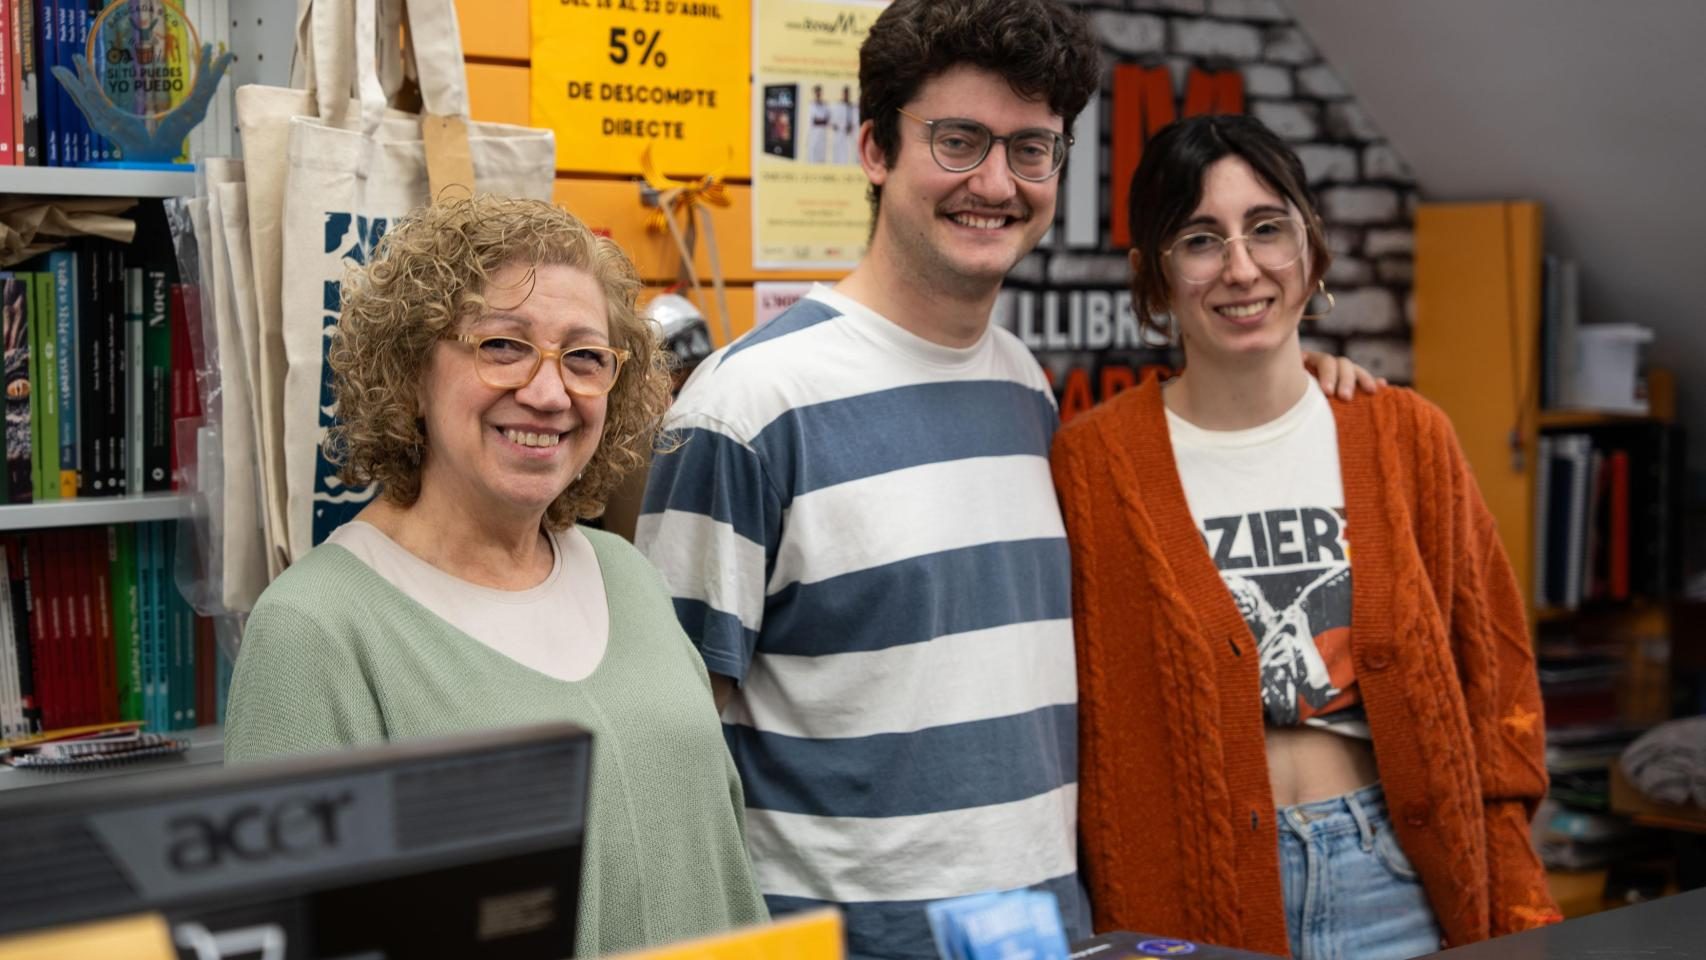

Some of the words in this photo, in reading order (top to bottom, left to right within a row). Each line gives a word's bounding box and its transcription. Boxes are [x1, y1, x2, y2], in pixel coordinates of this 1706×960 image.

[619, 0, 637, 11] AL
[609, 27, 667, 68] 5%
[108, 68, 118, 79] SI
[140, 67, 182, 78] PUEDES
[108, 80, 130, 93] YO
[134, 79, 183, 92] PUEDO
[567, 81, 594, 100] DE
[600, 82, 718, 109] DESCOMPTE
[602, 117, 686, 140] DIRECTE
[150, 271, 165, 327] Noesi
[1200, 506, 1346, 571] ZIER
[167, 792, 354, 873] acer
